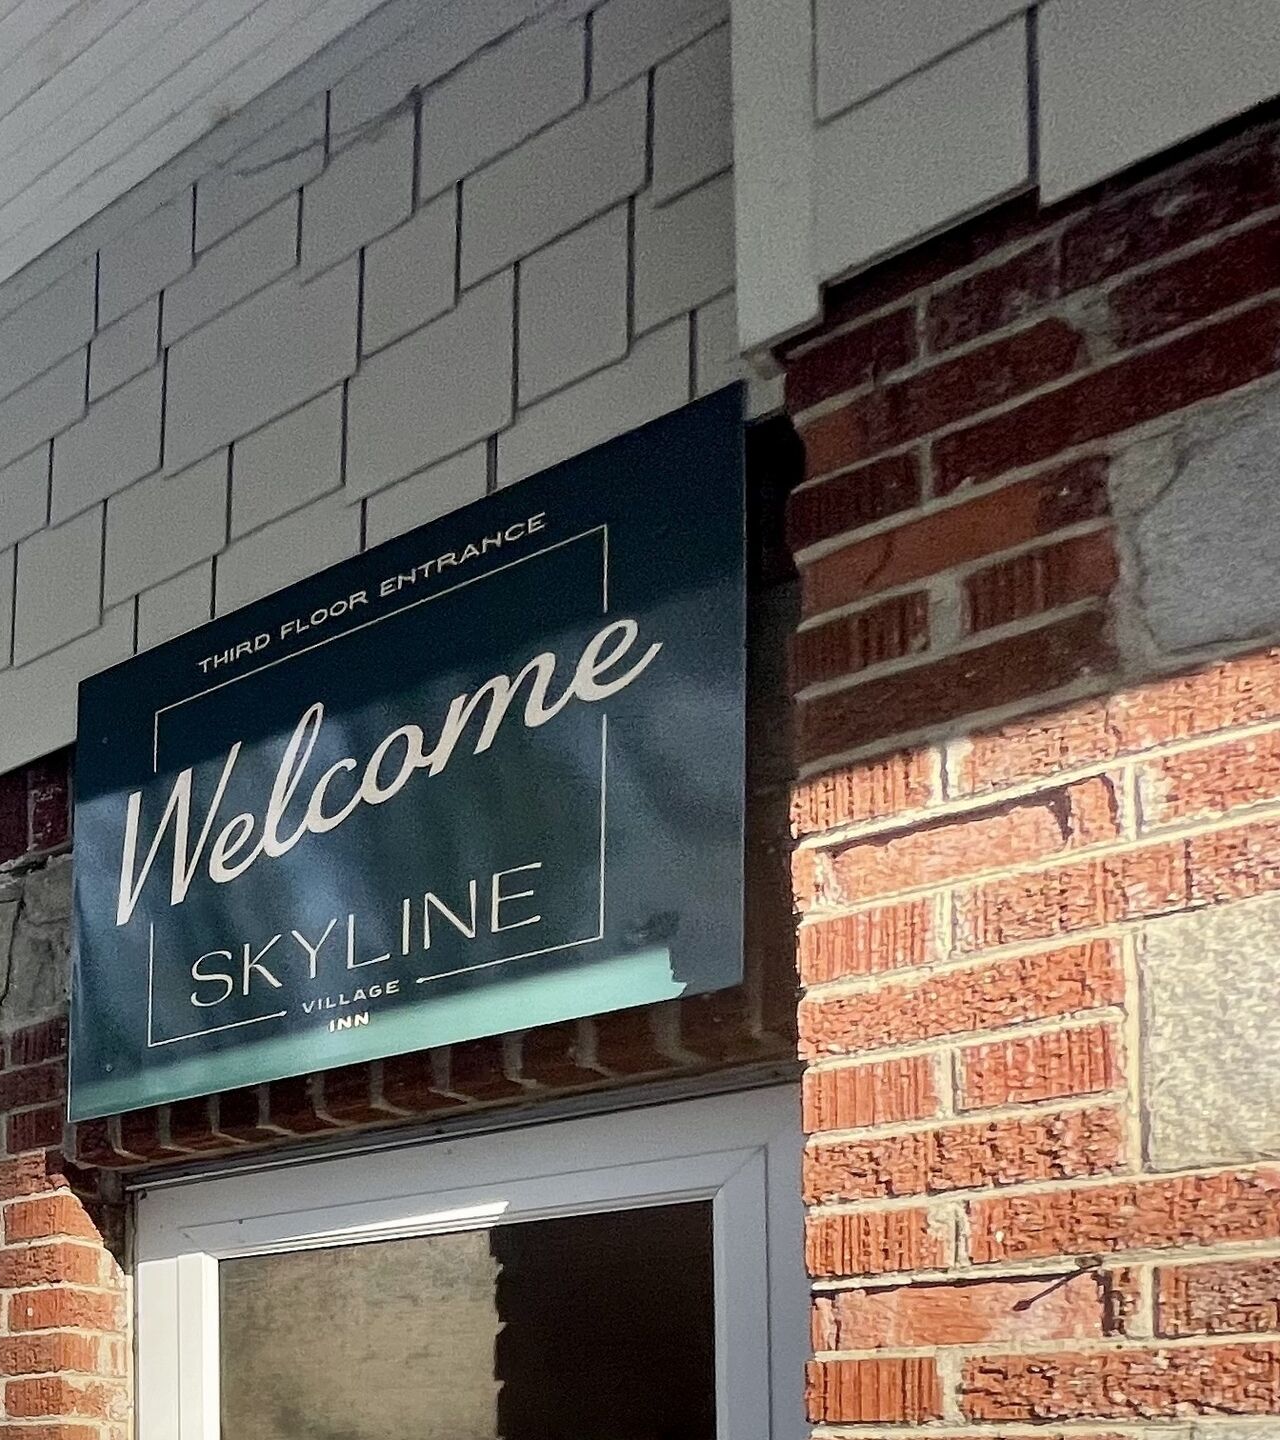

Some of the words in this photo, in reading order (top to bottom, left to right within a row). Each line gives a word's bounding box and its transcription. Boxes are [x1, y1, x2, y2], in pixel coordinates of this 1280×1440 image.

[198, 632, 271, 673] THIRD
[280, 591, 368, 640] FLOOR
[379, 512, 546, 597] ENTRANCE
[116, 618, 663, 926] Welcome
[190, 862, 543, 1007] SKYLINE
[301, 979, 401, 1014] VILLAGE
[328, 1011, 370, 1032] INN
